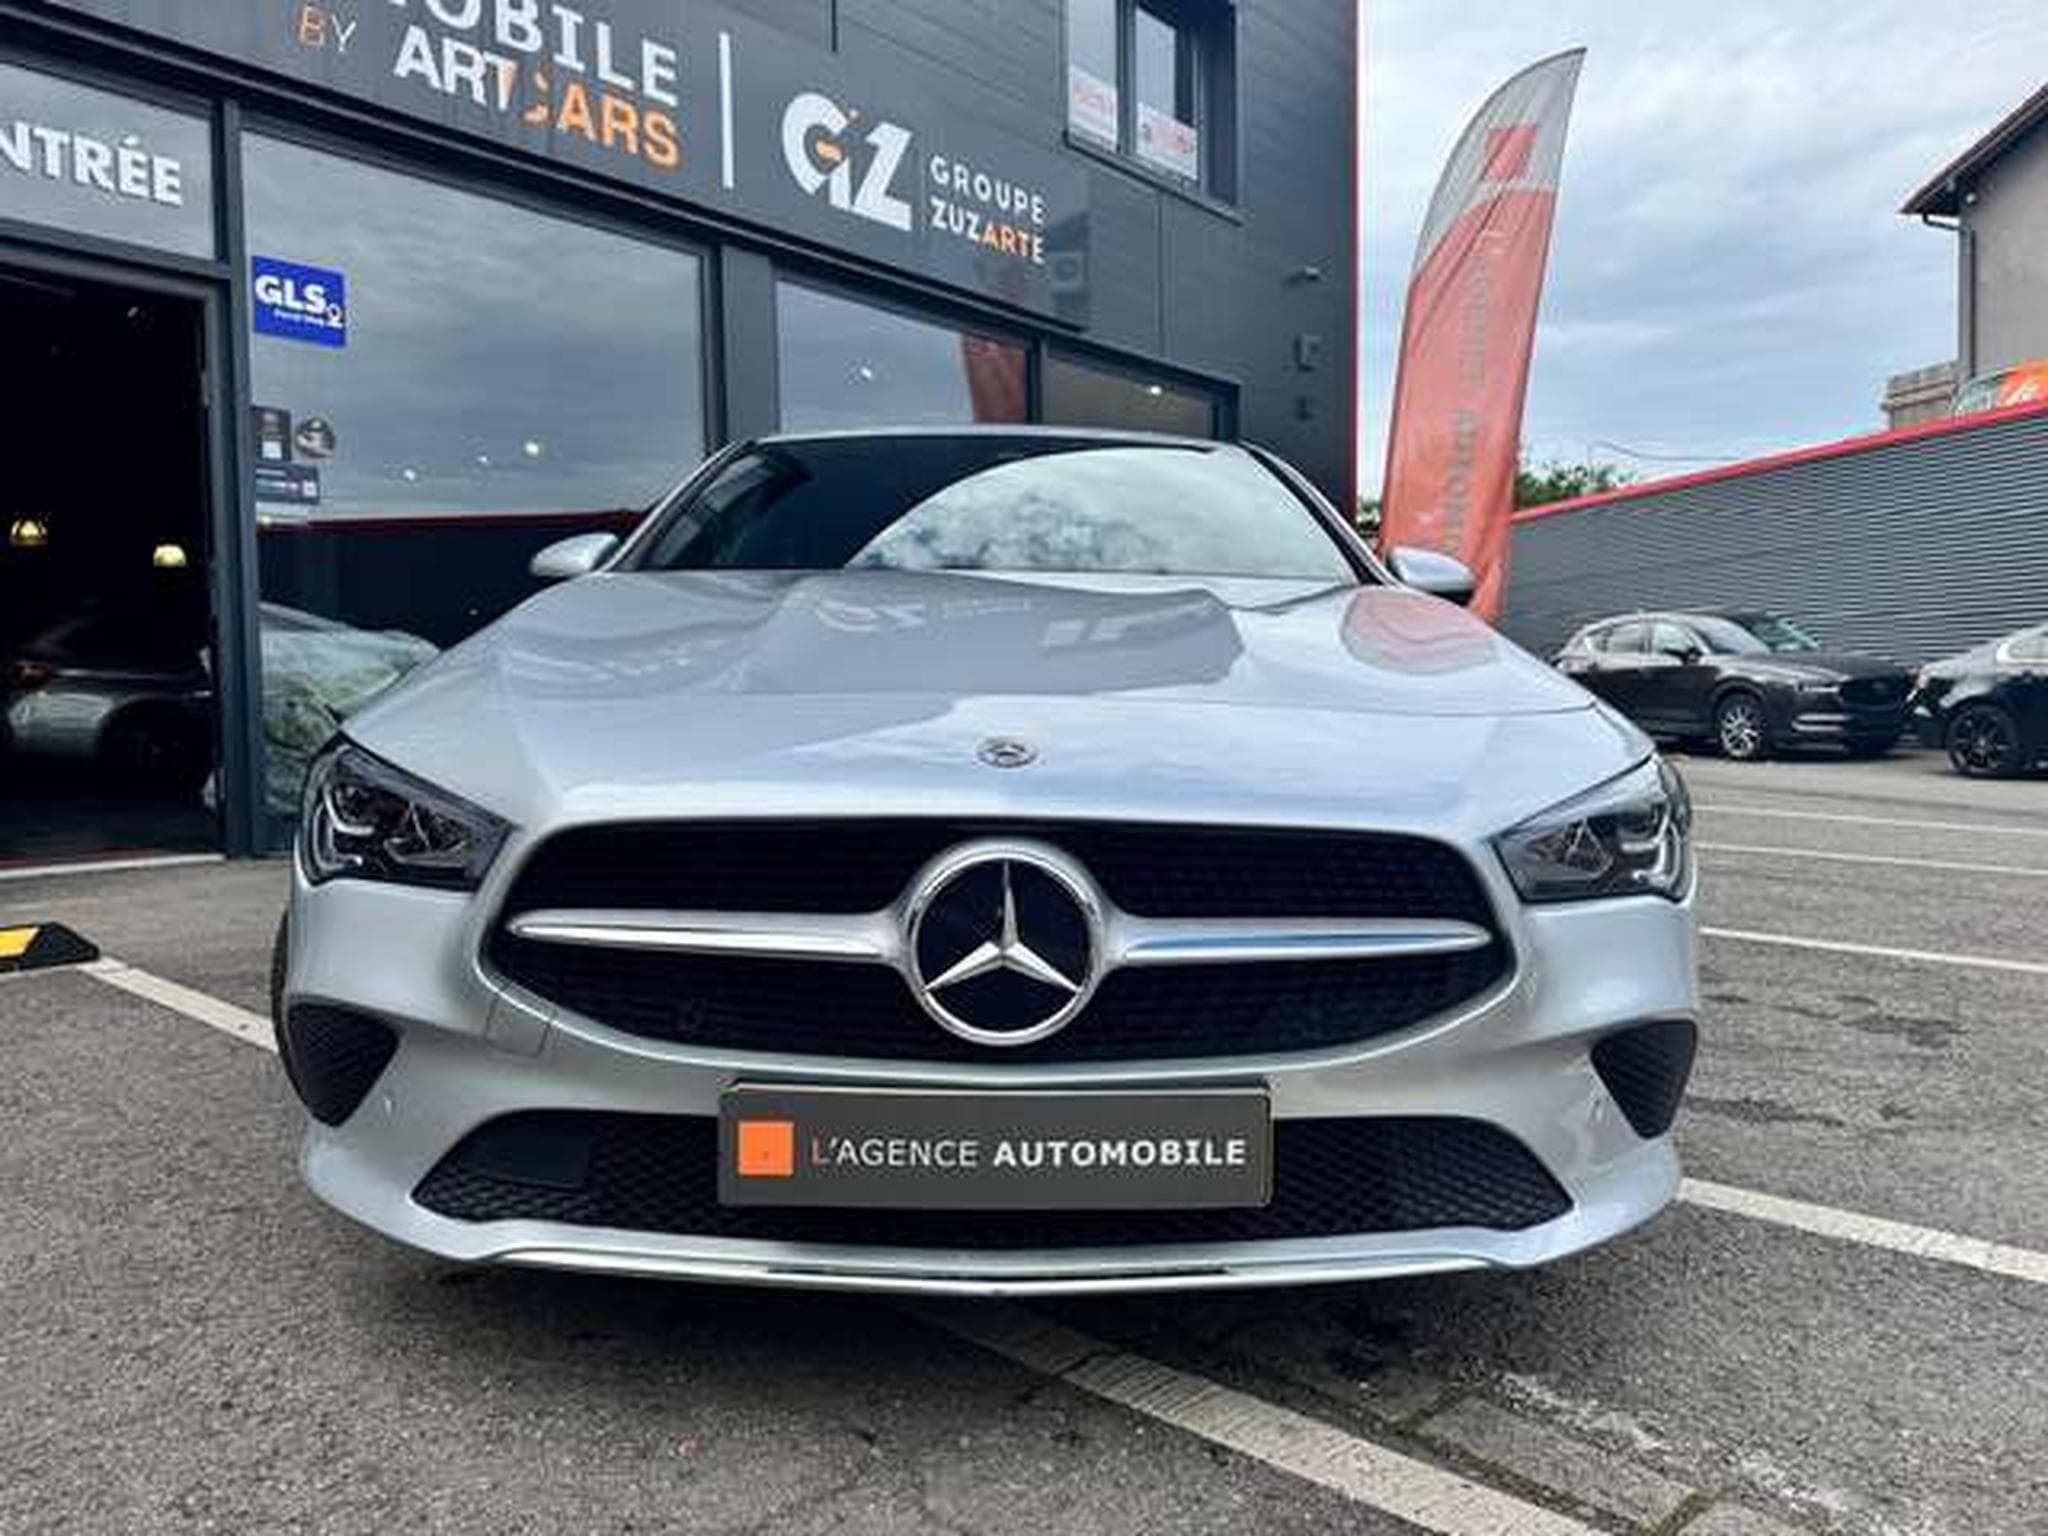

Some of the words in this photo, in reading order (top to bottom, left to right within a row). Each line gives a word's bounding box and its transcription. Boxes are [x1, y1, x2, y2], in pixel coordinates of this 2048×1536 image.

[300, 6, 357, 53] BY
[930, 155, 1044, 225] GROUPE
[930, 196, 1045, 264] ZUZARTE
[255, 275, 326, 315] GLS
[811, 1138, 979, 1167] L'AGENCE
[993, 1140, 1247, 1168] AUTOMOBILE
